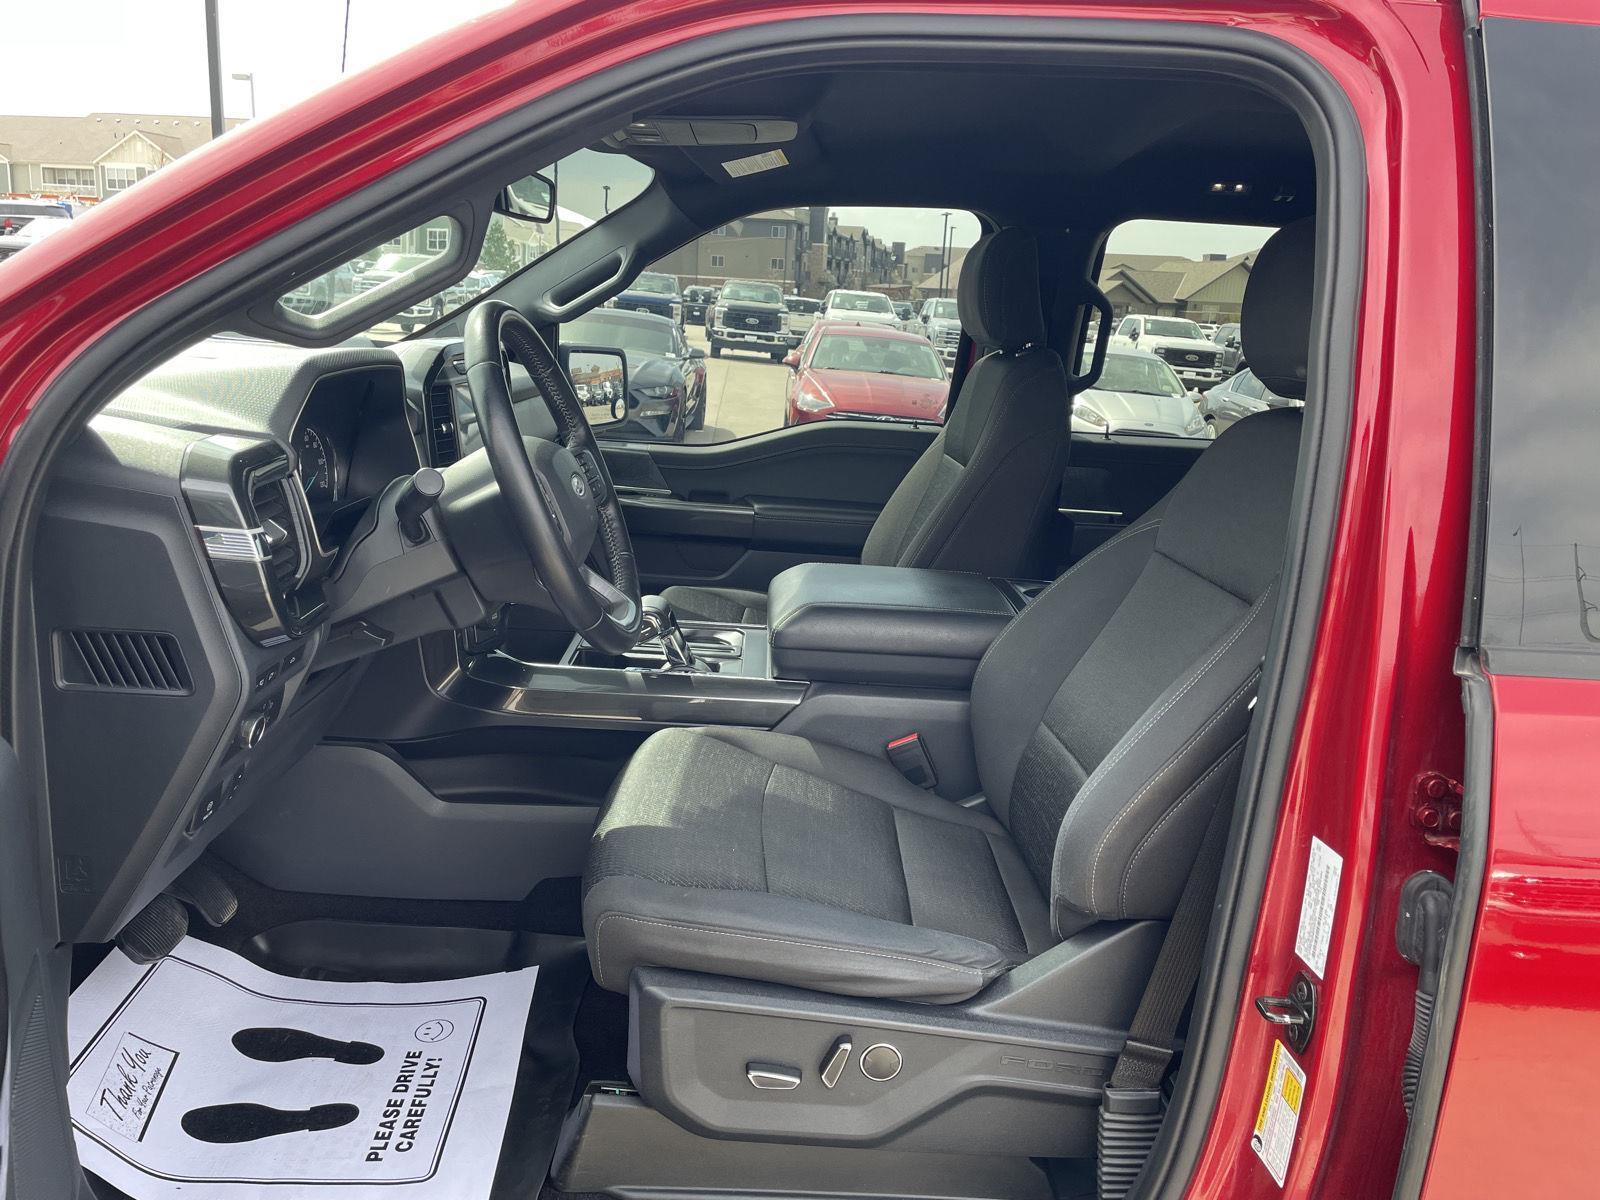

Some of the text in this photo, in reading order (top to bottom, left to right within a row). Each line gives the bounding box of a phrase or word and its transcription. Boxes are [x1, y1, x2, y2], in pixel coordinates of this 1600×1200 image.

[100, 1047, 151, 1121] Thank You
[365, 1050, 423, 1162] PLEASE DRIVE
[395, 1058, 443, 1153] CAREFULLY!
